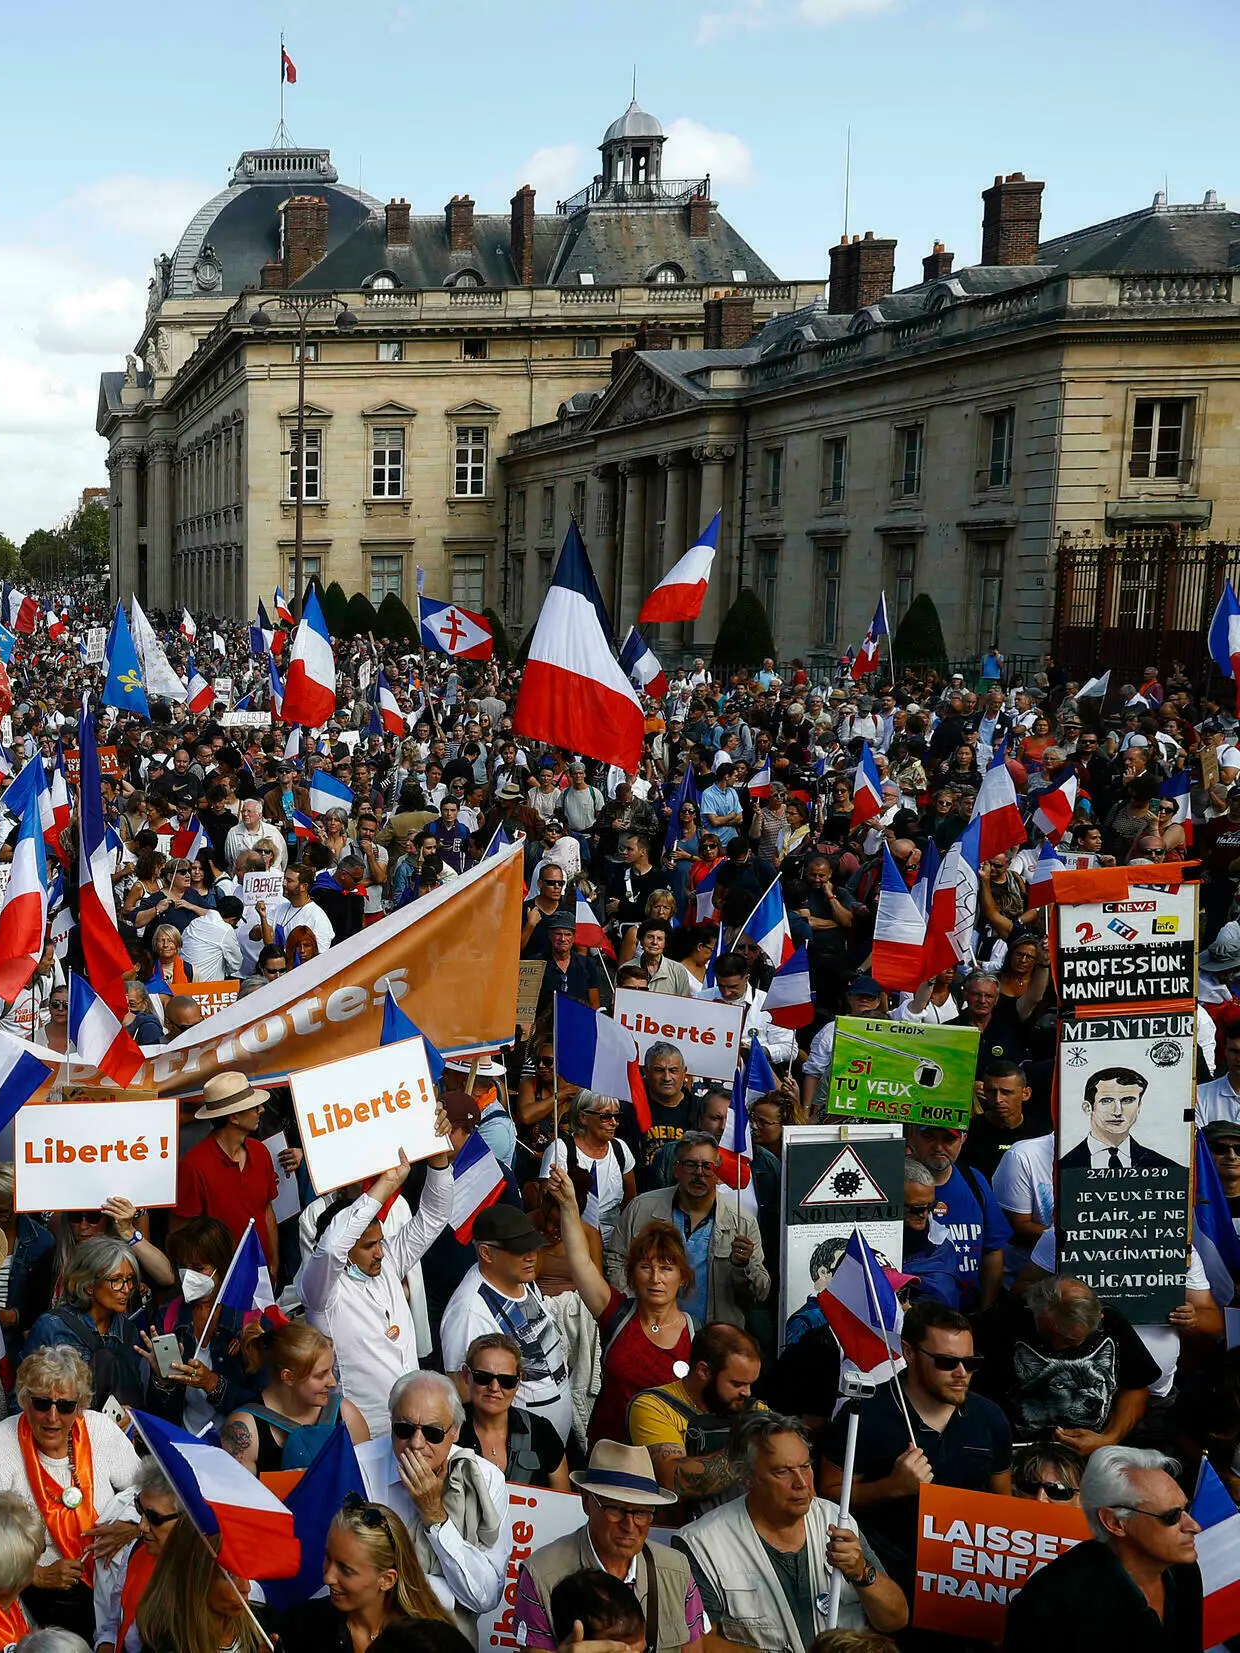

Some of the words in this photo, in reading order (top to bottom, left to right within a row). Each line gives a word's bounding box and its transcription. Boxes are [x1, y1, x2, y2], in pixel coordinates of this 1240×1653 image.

[1064, 946, 1079, 954] LES
[213, 992, 238, 1004] LES
[54, 967, 410, 1088] Ptriotes
[620, 1013, 716, 1046] Liberté
[725, 1031, 734, 1049] !
[865, 1022, 881, 1033] LE
[1063, 1015, 1194, 1041] MENTEUR
[835, 1077, 858, 1091] TU
[866, 1079, 913, 1097] VEUX
[307, 1082, 412, 1139] Liberté
[417, 1077, 428, 1102] !
[835, 1096, 857, 1110] LE
[24, 1136, 149, 1165] Liberté
[160, 1136, 169, 1159] !
[1086, 1168, 1169, 1179] 24/11/2020
[1094, 1190, 1141, 1202] VEUX
[1144, 1188, 1186, 1200] ÊTRE
[791, 1204, 900, 1224] NOUVEAU
[1137, 1210, 1157, 1220] JE
[1163, 1209, 1185, 1220] NE
[1155, 1226, 1186, 1239] PAS
[1061, 1251, 1080, 1263] LA
[1075, 1269, 1187, 1289] LIGATOIRE
